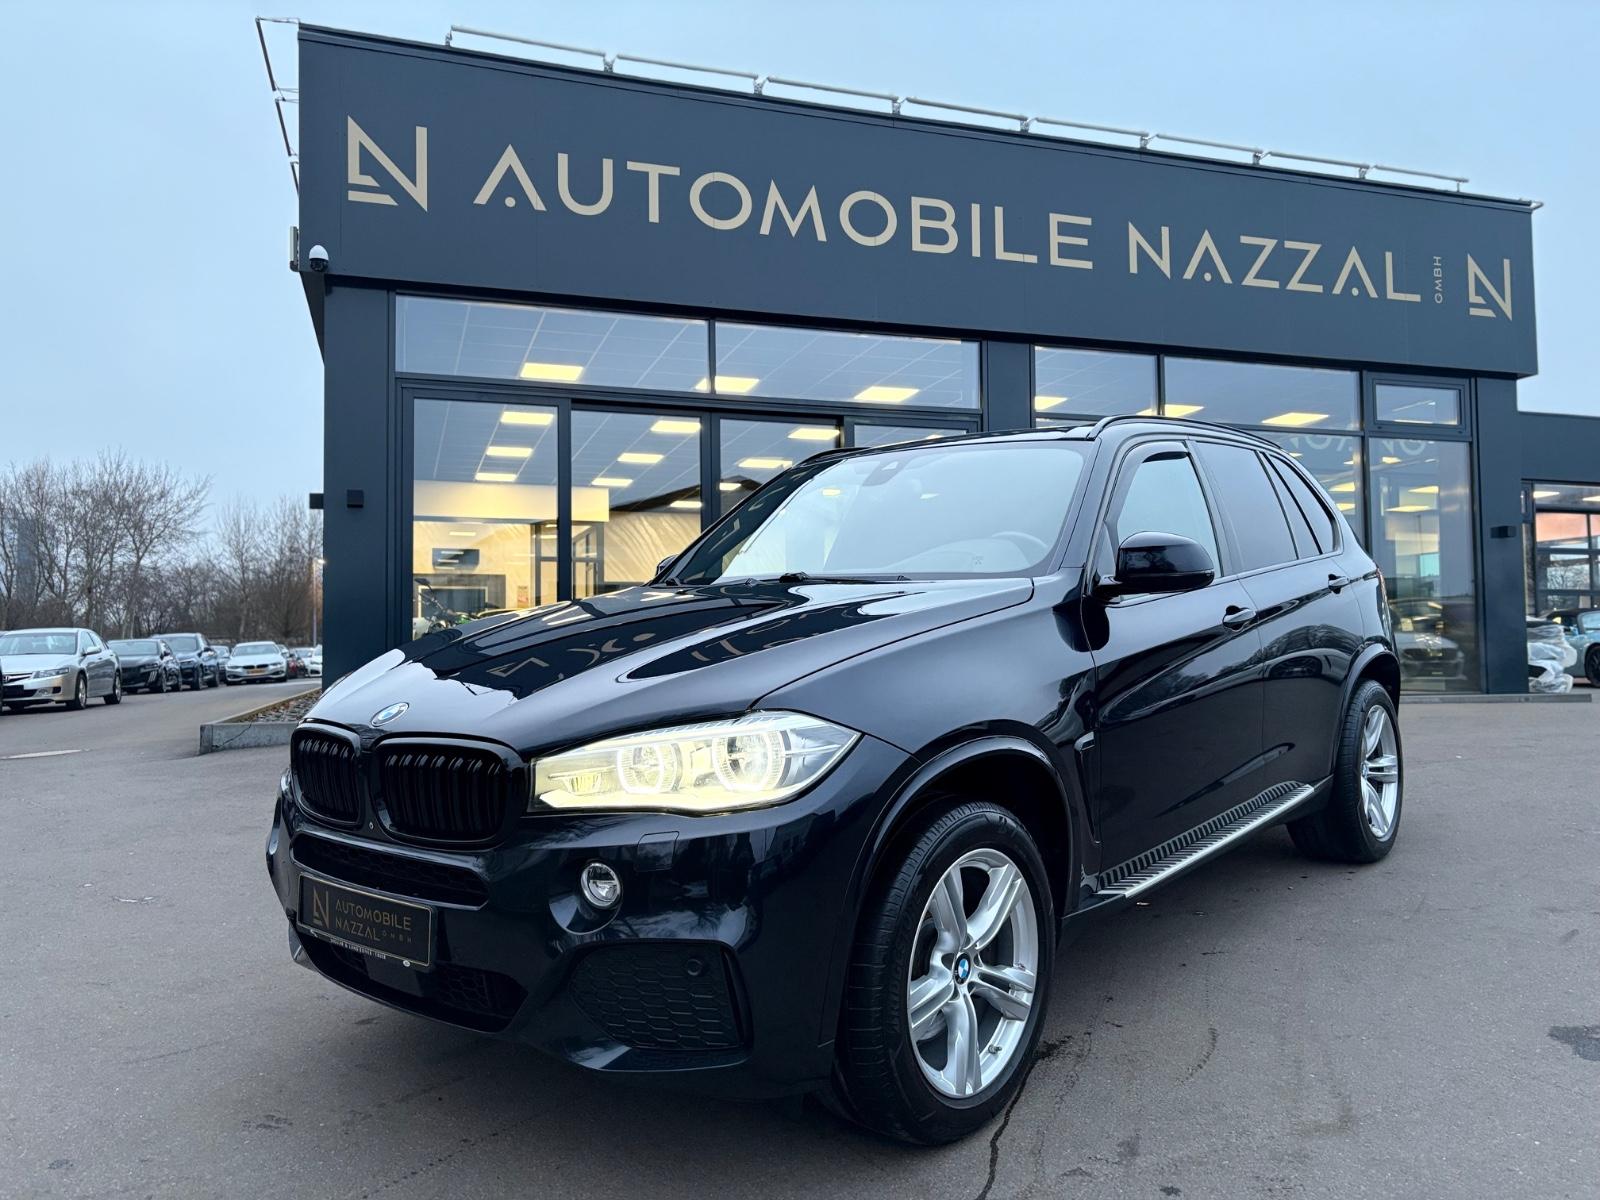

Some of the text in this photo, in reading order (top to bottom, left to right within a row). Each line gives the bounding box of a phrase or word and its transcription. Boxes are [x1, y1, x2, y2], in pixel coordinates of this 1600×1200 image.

[474, 144, 1093, 270] AUTOMOBILE
[1128, 222, 1422, 303] NAZZAL
[1433, 255, 1443, 304] GMBH
[335, 899, 412, 931] AUTOMOBILE
[335, 917, 381, 942] NAZZAL
